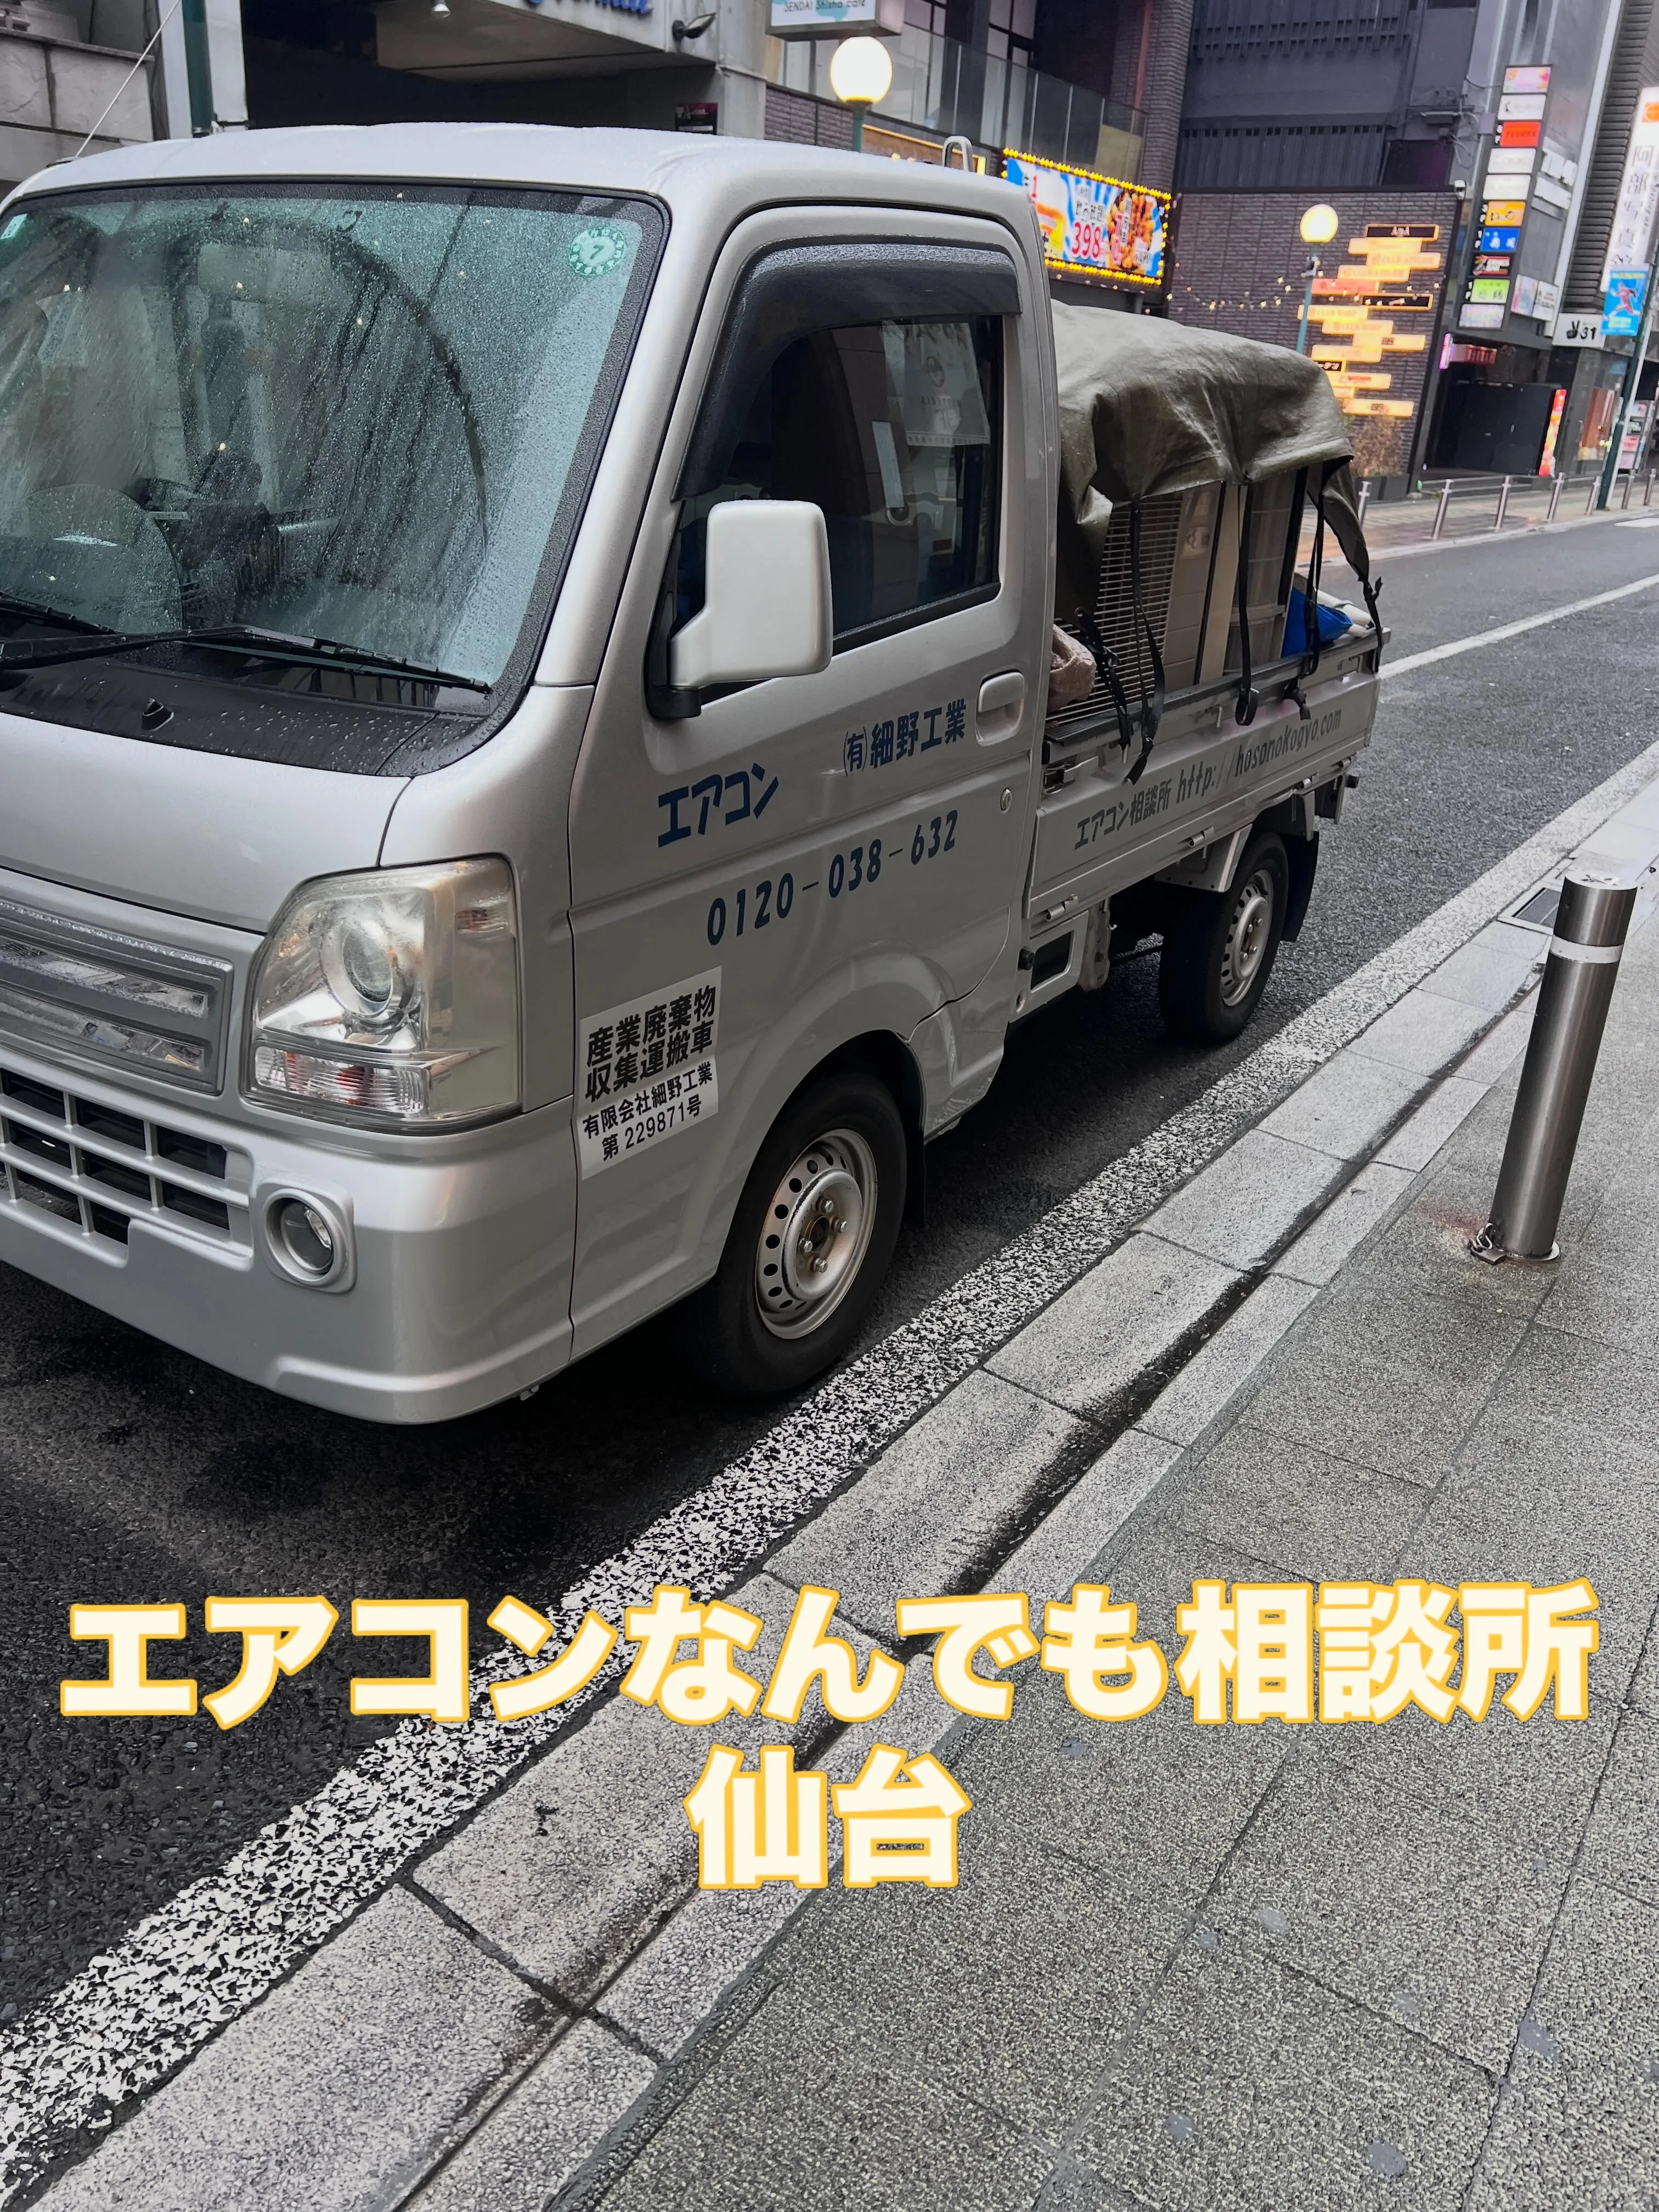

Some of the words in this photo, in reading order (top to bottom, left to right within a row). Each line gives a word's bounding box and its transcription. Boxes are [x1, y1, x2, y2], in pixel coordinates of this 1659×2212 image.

[785, 2, 813, 12] SENDAI
[1071, 221, 1101, 258] 398
[658, 763, 779, 848] エアコン
[1074, 778, 1172, 850] エアコン相談所
[585, 1019, 714, 1103] 収集運搬車
[586, 985, 716, 1067] 産業廃棄物
[583, 1061, 713, 1139] 有限会社細野工業
